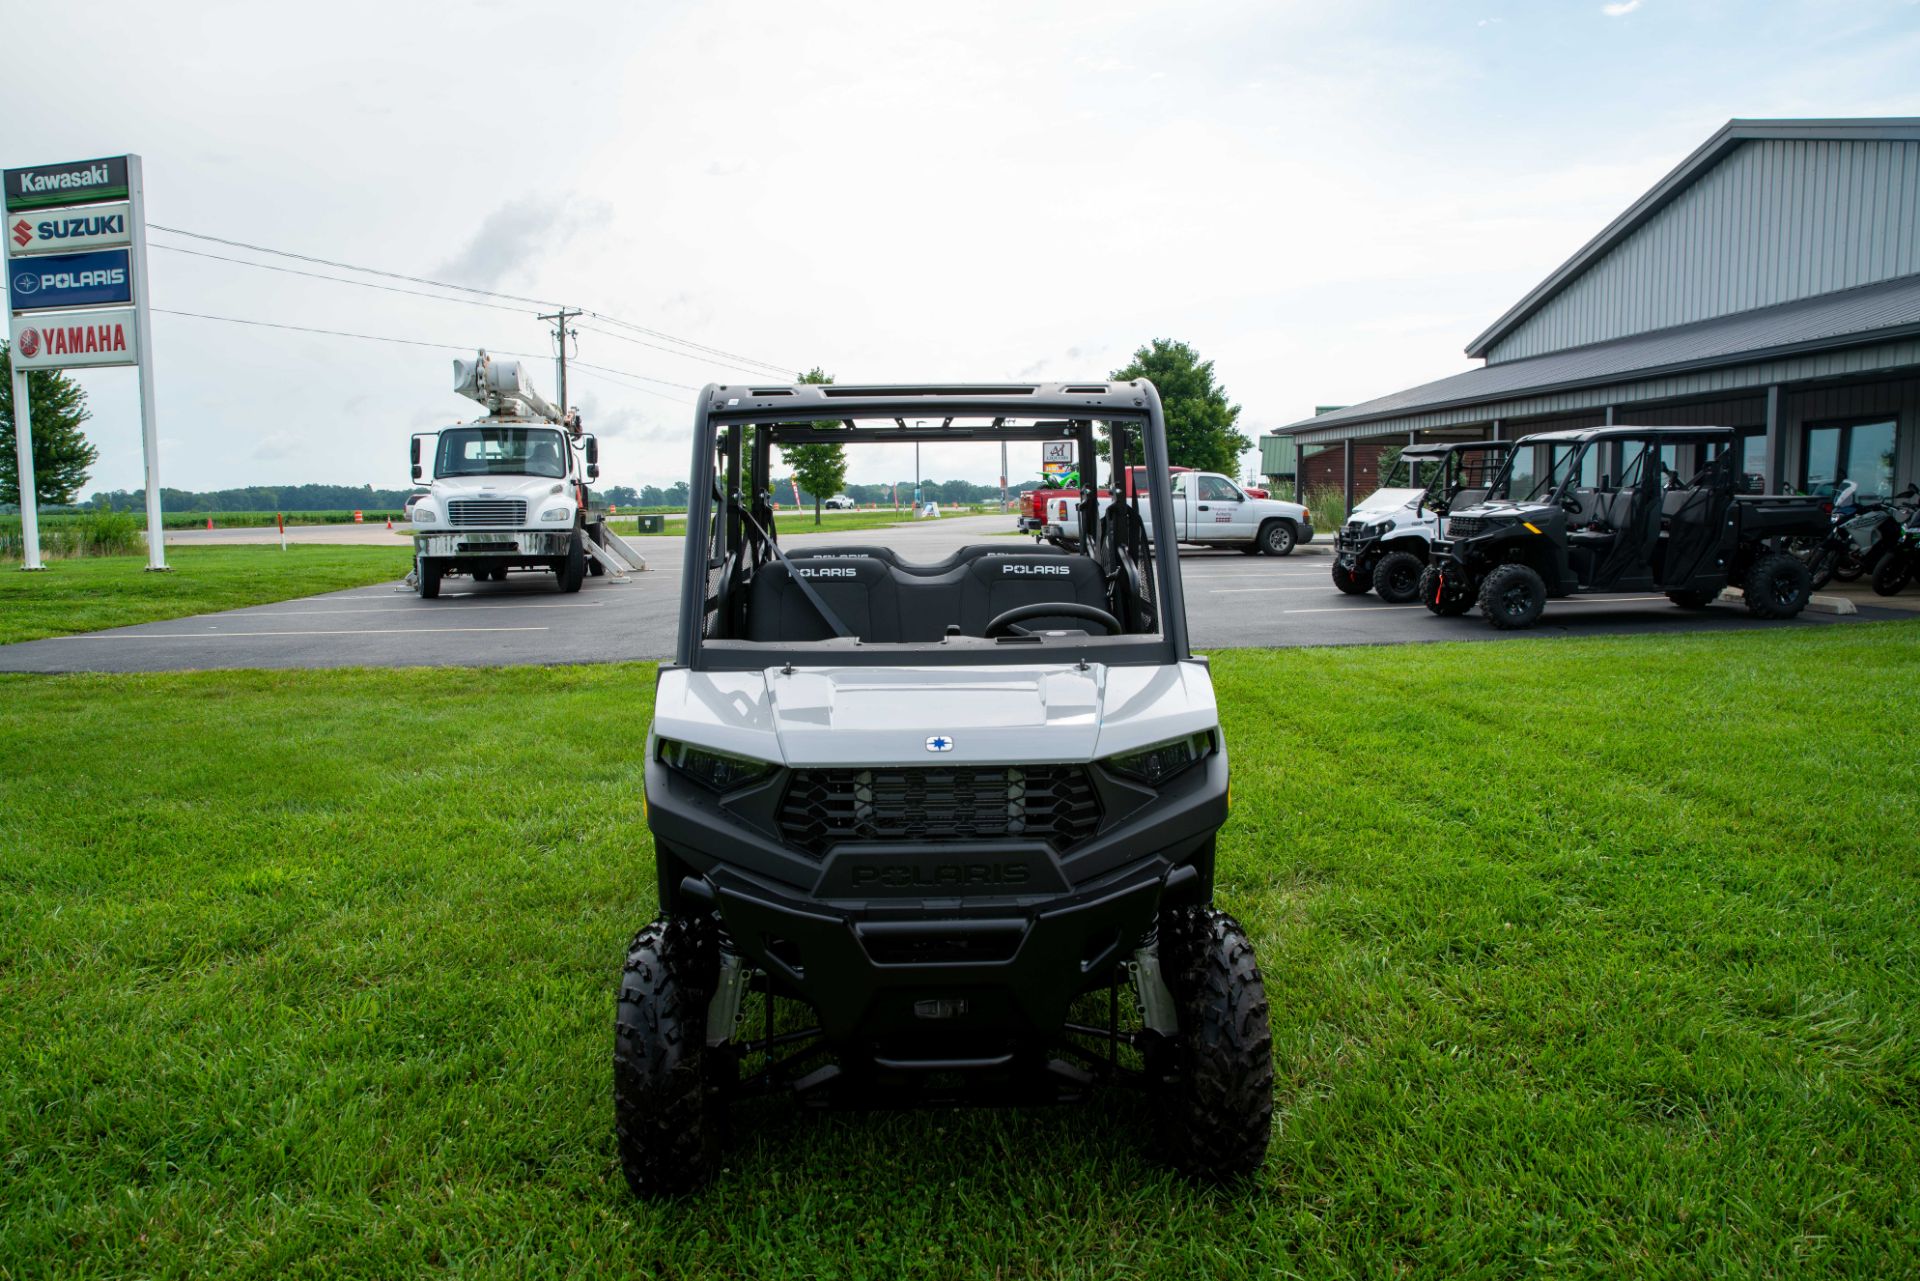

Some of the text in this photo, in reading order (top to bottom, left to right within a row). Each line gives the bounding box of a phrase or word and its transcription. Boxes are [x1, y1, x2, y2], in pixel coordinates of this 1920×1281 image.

[20, 164, 109, 193] Kawasaki
[37, 214, 124, 240] SUZUKI
[41, 268, 125, 290] POLARIS
[42, 323, 126, 355] YAMAHA
[1002, 564, 1070, 575] POLARIS
[852, 863, 1031, 888] POLARIS
